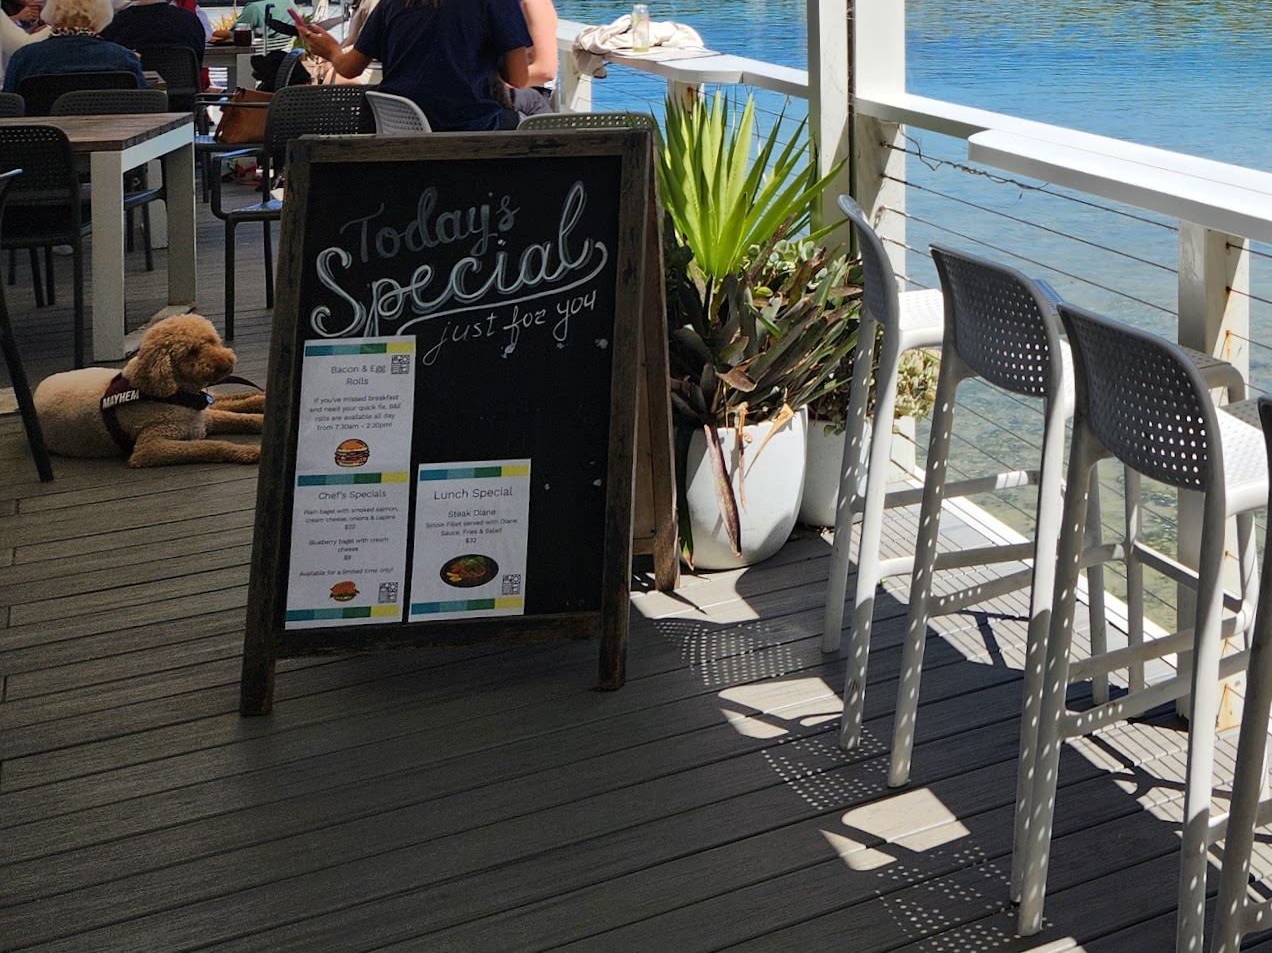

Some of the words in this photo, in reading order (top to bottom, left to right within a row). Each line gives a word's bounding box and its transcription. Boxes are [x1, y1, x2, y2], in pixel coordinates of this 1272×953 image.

[340, 186, 520, 263] Today's
[310, 180, 593, 338] Special
[422, 312, 497, 366] just
[503, 306, 547, 351] for
[553, 290, 597, 342] you
[331, 366, 359, 374] Bacon
[370, 365, 386, 374] Egg
[346, 377, 369, 386] Rolls
[102, 389, 140, 409] MAYHEM
[320, 397, 341, 405] you've
[342, 406, 357, 414] your
[359, 404, 376, 412] quick
[319, 492, 347, 500] Chef's
[350, 490, 387, 500] Specials
[434, 489, 469, 500] Lunch
[472, 487, 513, 499] Special
[448, 510, 471, 518] Steak
[474, 509, 496, 517] Diane
